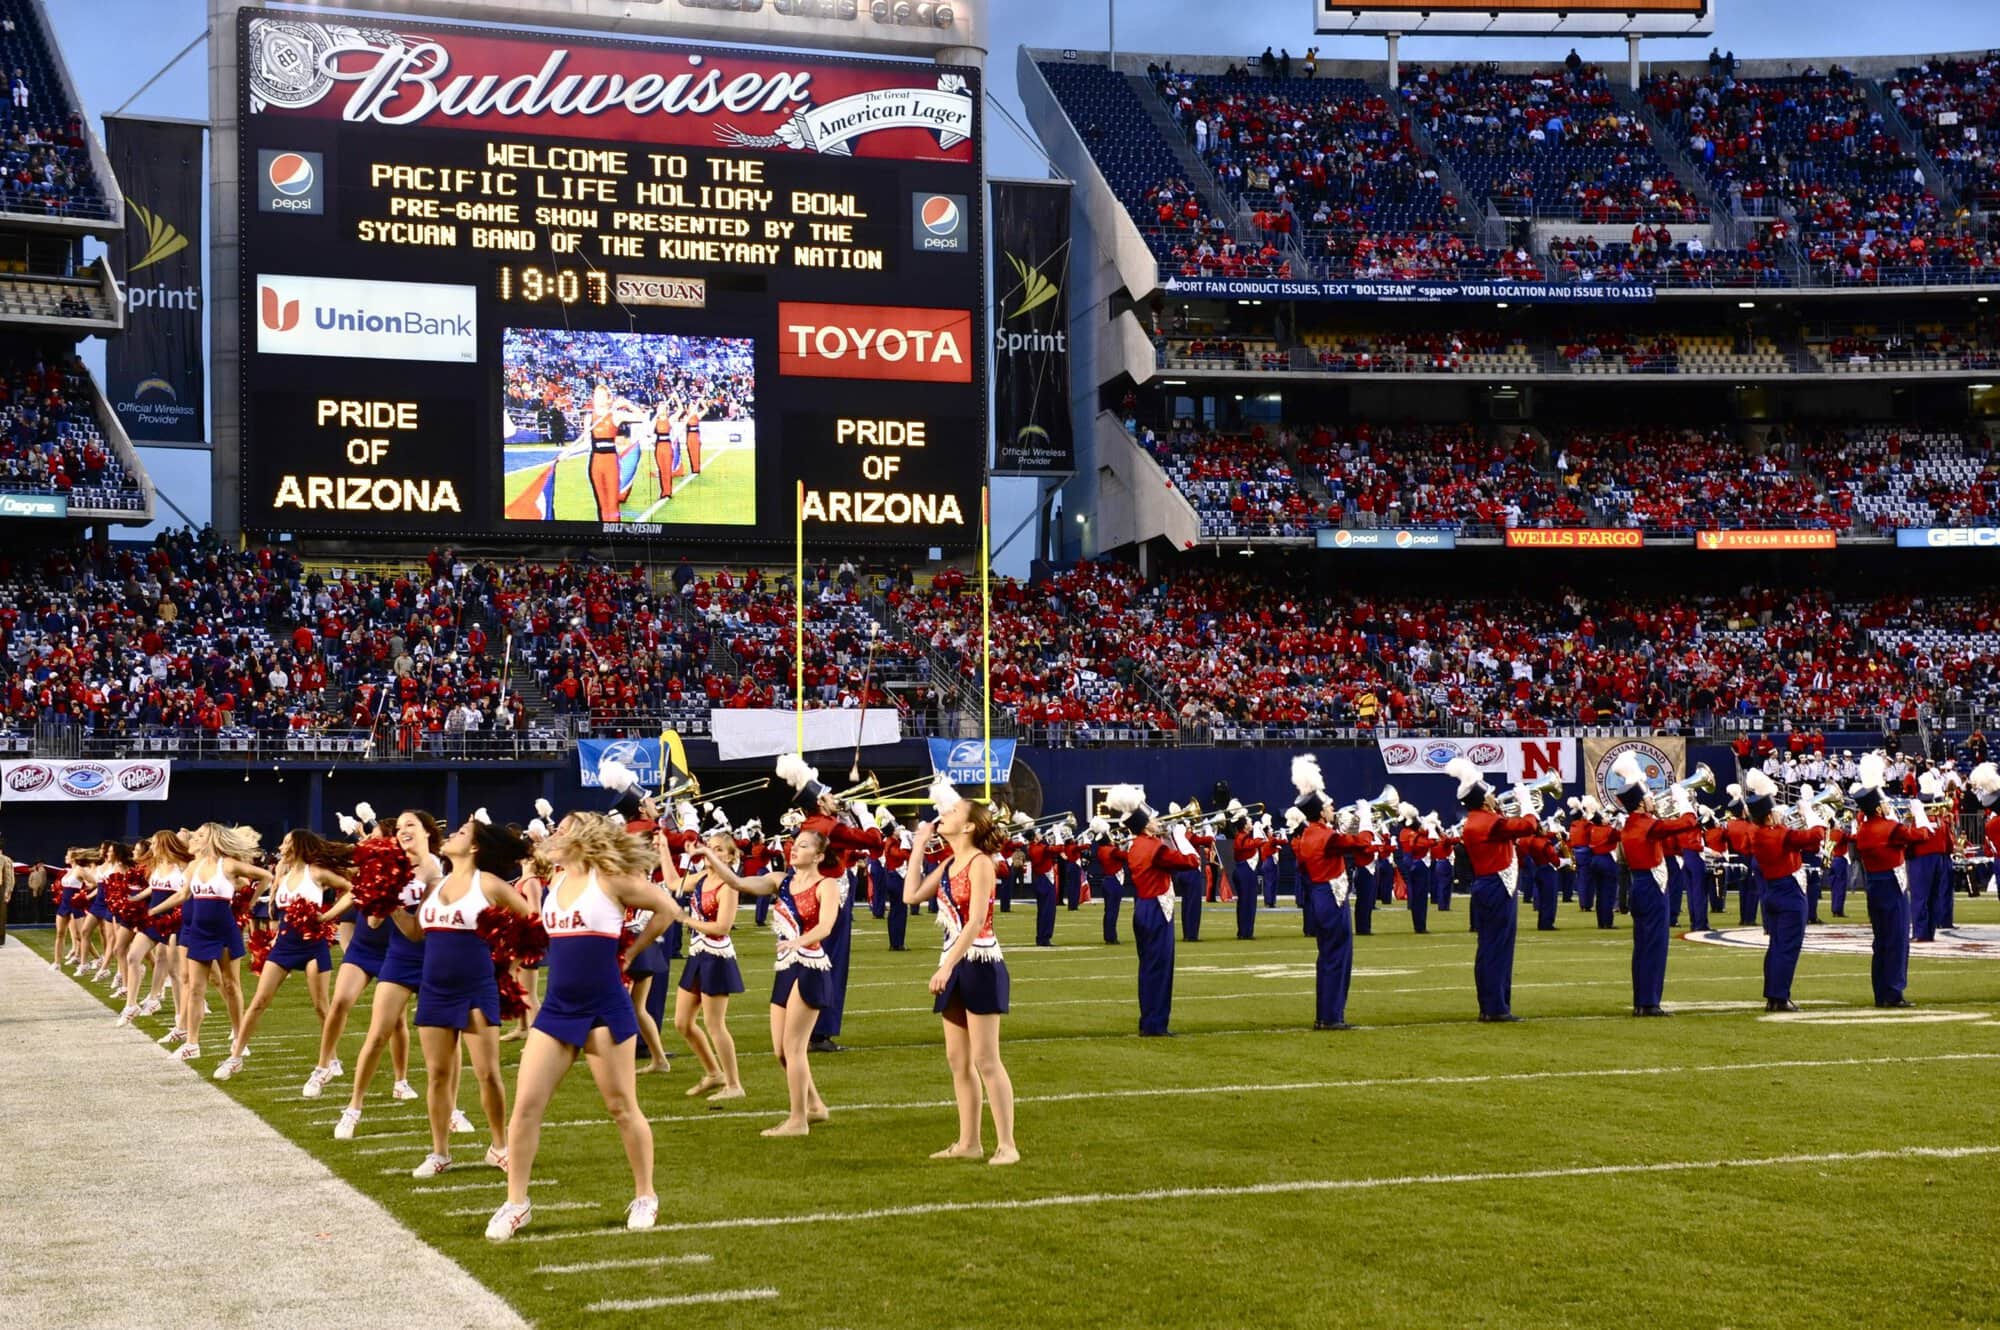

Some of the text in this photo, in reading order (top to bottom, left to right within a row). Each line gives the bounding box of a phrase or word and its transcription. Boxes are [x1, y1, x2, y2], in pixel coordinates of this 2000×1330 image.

[318, 43, 811, 125] Budweiser
[865, 90, 910, 102] The Great
[819, 101, 967, 140] American Lager
[487, 143, 764, 183] WELCOME TO THE
[371, 164, 867, 218] PACIFIC LIFE HOLIDAY BOWL
[272, 198, 311, 211] pepsi
[391, 198, 853, 243] PRE-GAME SHOW PRESENTED BY THE
[358, 220, 456, 247] SYCUAN
[472, 228, 535, 251] BAND
[551, 233, 582, 253] OF
[598, 235, 645, 257] THE
[795, 246, 882, 270] NATION
[924, 237, 958, 249] pepsi
[618, 280, 703, 301] SYCUAN
[1206, 281, 1227, 293] FAN
[1229, 282, 1279, 294] CONDUCT
[1323, 284, 1349, 295] TEXT
[1461, 286, 1490, 296] YOUR
[1492, 286, 1543, 297] LOCATION
[1545, 286, 1571, 297] AND
[1573, 286, 1604, 297] ISSUE
[1605, 287, 1620, 297] TO
[315, 307, 472, 337] UnionBank
[789, 325, 963, 364] TOYOTA
[996, 327, 1066, 357] Sprint
[117, 402, 195, 415] Official Wireless
[138, 413, 179, 424] Provider
[317, 400, 418, 429] PRIDE
[837, 419, 925, 447] PRIDE
[347, 439, 389, 465] OF
[1001, 447, 1067, 457] Official Wireless
[1017, 456, 1051, 465] Provider
[863, 455, 900, 480] OF
[273, 475, 461, 513] ARIZONA
[801, 491, 964, 525] ARIZONA
[1353, 534, 1378, 544] pepsi
[1413, 534, 1439, 544] pepsi
[1510, 531, 1640, 545] WELLS FARGO
[1729, 534, 1832, 545] SYCUAN RESORT
[1927, 527, 2000, 547] GEIC
[1521, 742, 1561, 779] N
[1603, 743, 1638, 765] SYCUAN
[1640, 744, 1666, 764] BAND
[424, 908, 436, 923] U
[451, 909, 465, 926] A
[545, 911, 556, 929] U
[571, 910, 586, 929] A
